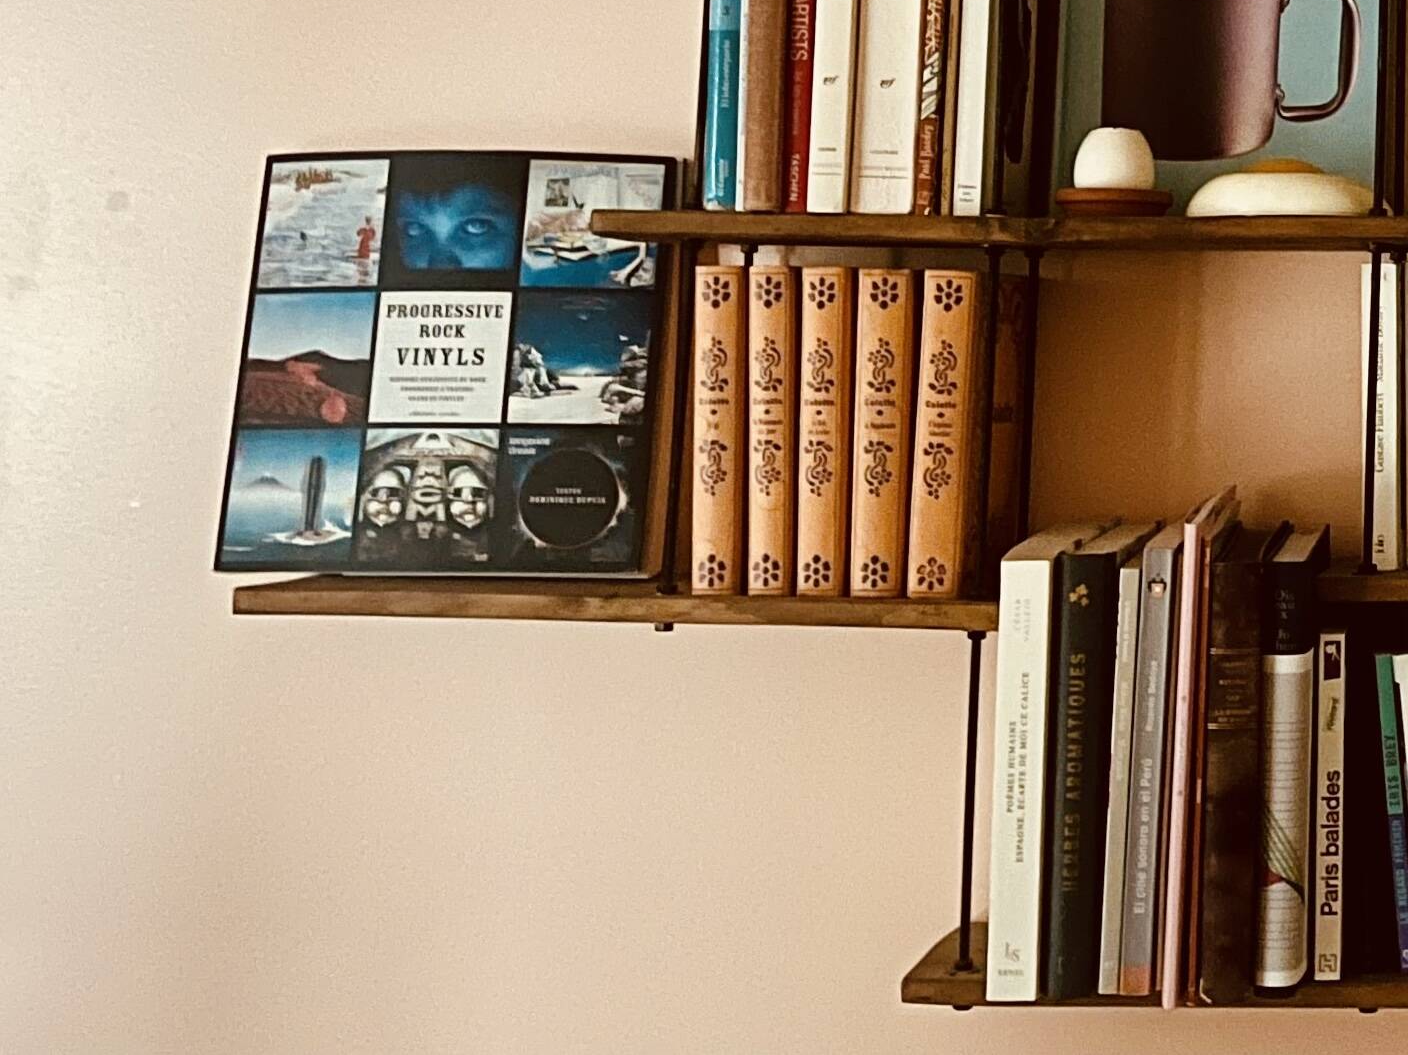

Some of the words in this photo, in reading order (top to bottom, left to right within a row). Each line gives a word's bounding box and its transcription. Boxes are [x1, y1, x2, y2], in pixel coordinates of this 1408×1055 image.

[385, 303, 504, 320] PROGRESSIVE
[418, 324, 466, 340] ROCK
[396, 347, 486, 366] VINYLS
[1020, 672, 1030, 710] CALICE
[1019, 712, 1029, 726] CE
[1065, 652, 1085, 801] AROMATIQUES
[1019, 730, 1028, 750] MOI
[1018, 753, 1027, 767] DE
[1139, 757, 1153, 787] Perú
[1138, 791, 1150, 803] el
[1138, 806, 1149, 822] en
[1320, 770, 1341, 857] balades
[1320, 863, 1339, 916] Paris
[1134, 902, 1146, 914] El
